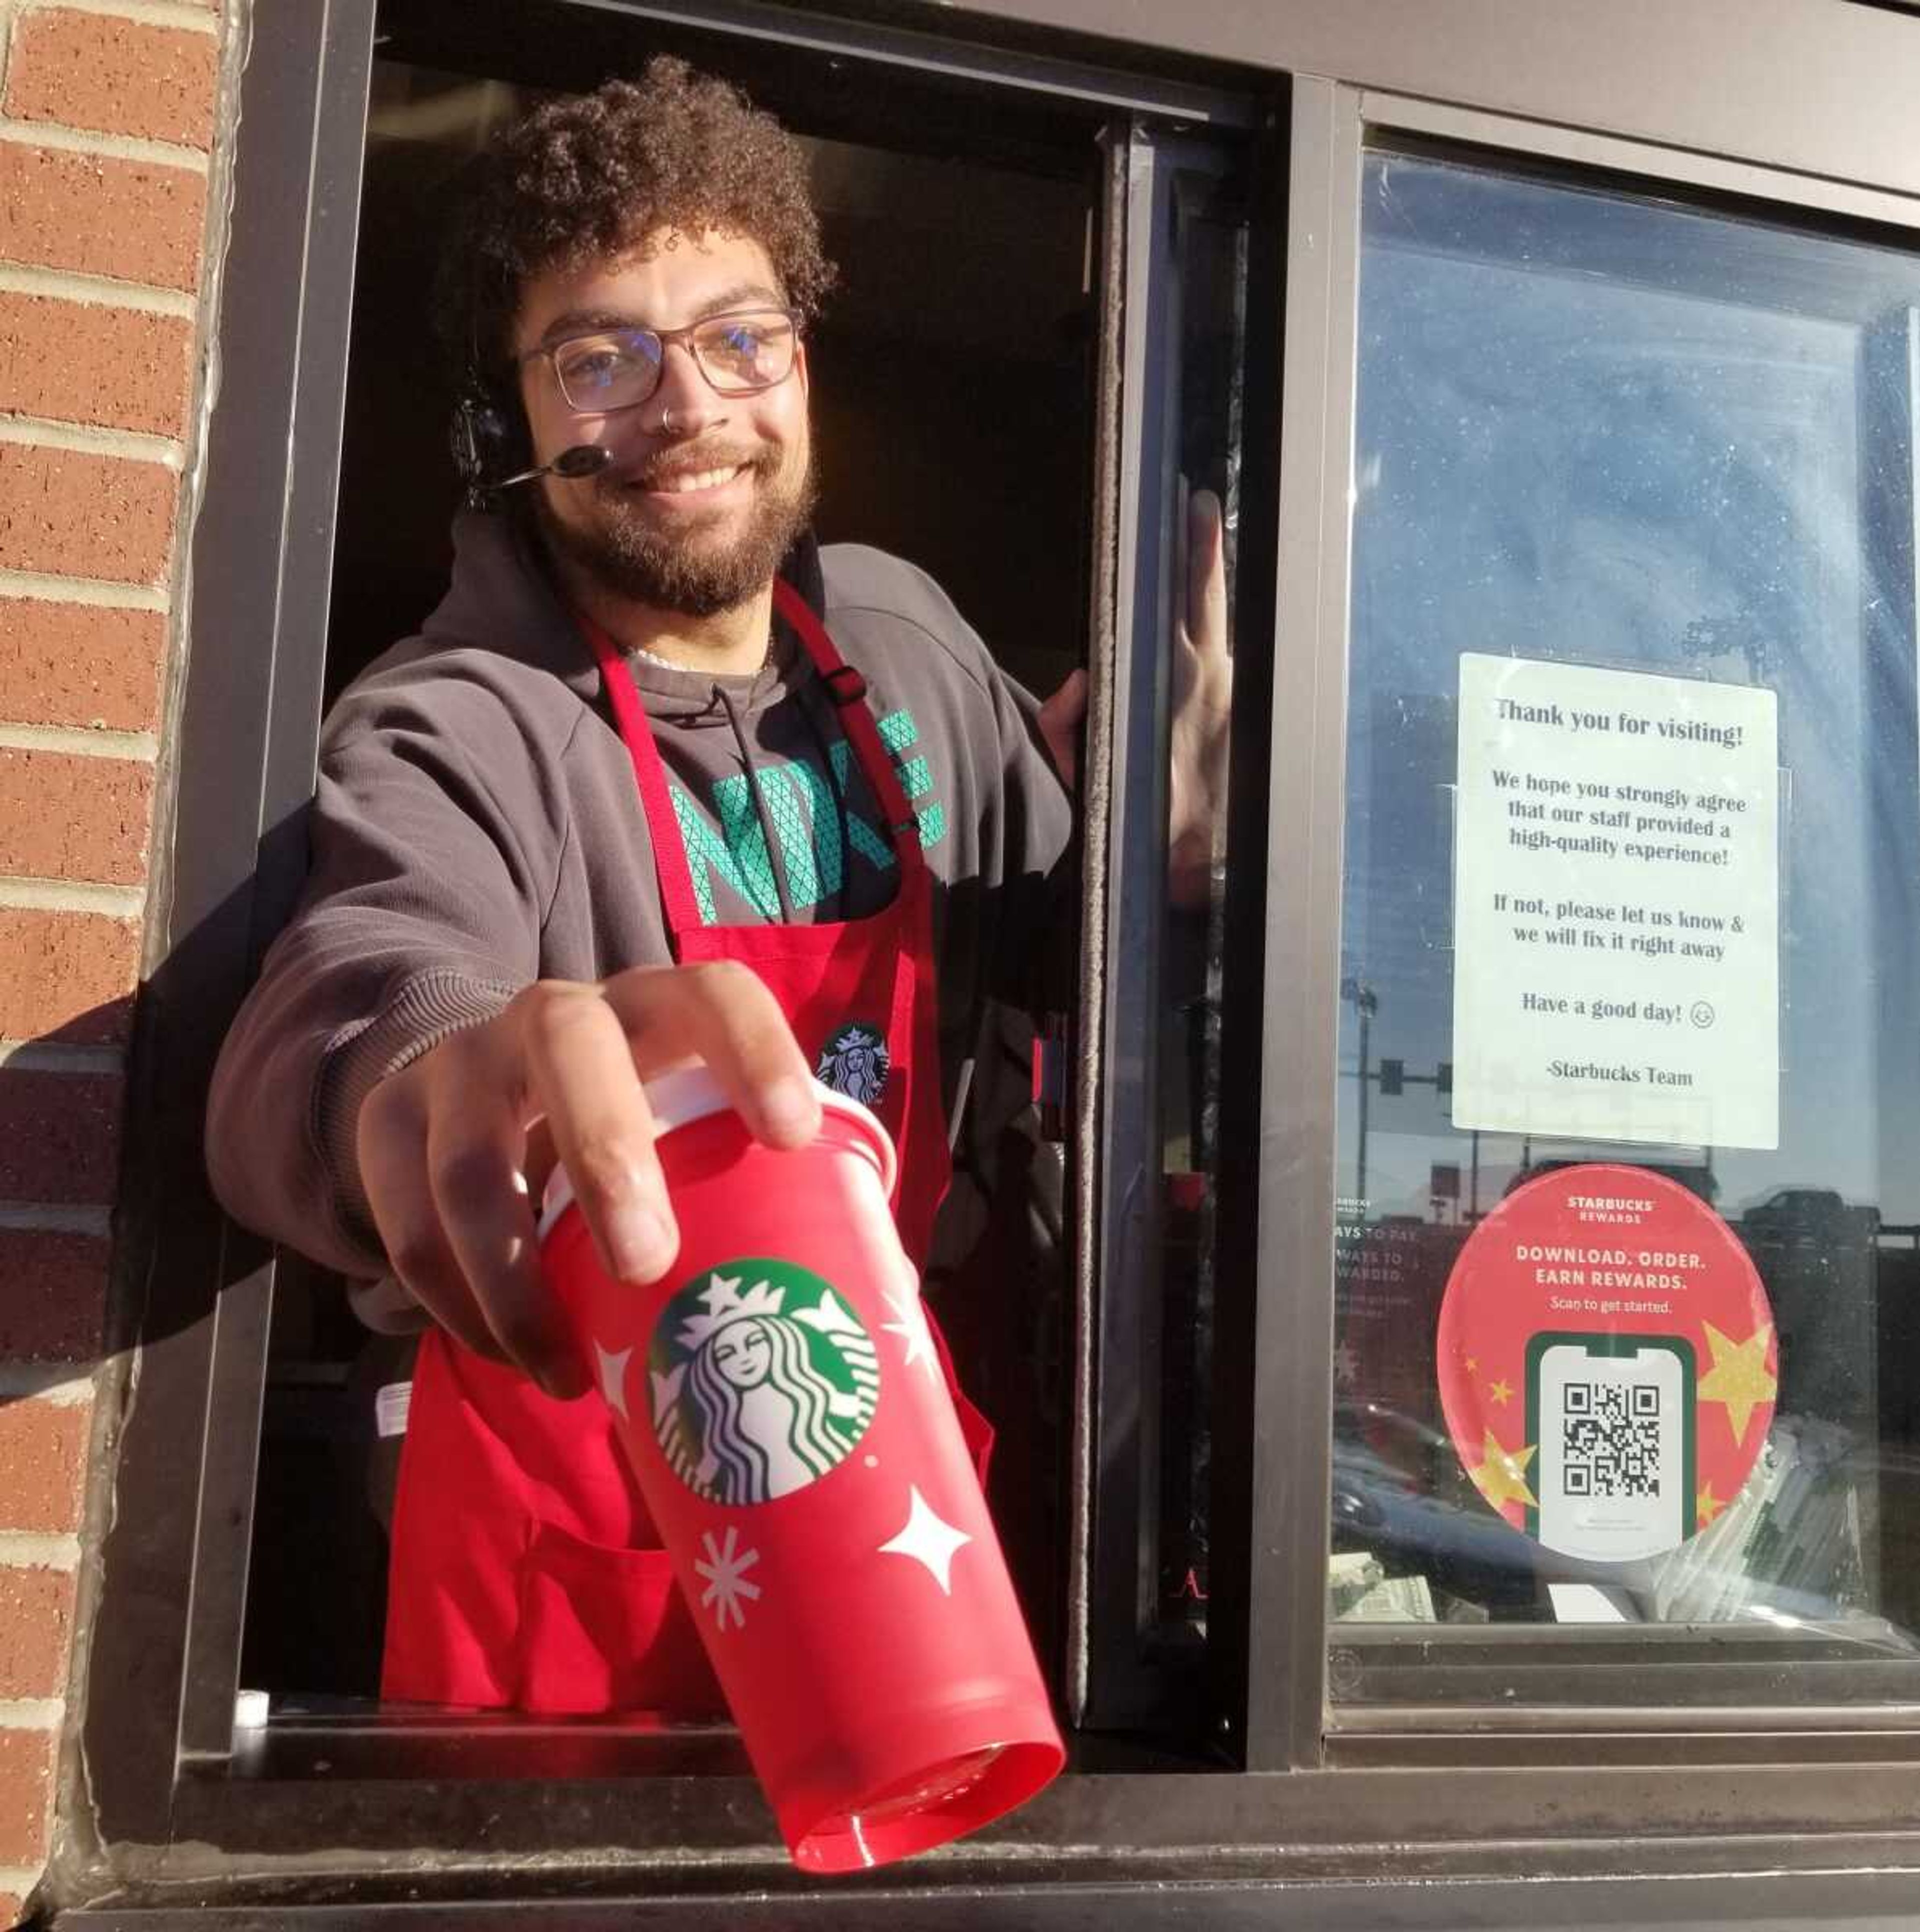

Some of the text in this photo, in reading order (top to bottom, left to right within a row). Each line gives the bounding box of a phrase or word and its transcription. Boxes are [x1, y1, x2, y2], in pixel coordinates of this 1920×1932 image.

[1496, 699, 1742, 749] Thank you for visiting!
[1493, 770, 1746, 813] We hope you strongly agree
[1508, 800, 1730, 838] that our staff provided a
[1510, 828, 1728, 865] high-quality experience!
[1494, 894, 1744, 932] If not, please let us know &
[1514, 928, 1724, 962] we will fix it right away
[1523, 993, 1681, 1024] Have a good day!
[1546, 1060, 1692, 1086] -Starbucks Team
[1568, 1196, 1652, 1211] STARBUCKS
[1580, 1211, 1640, 1224] REWARDS
[1517, 1246, 1705, 1268] DOWNLOAD. ORDER.
[1536, 1269, 1686, 1289] EARN REWARDS.
[1550, 1296, 1582, 1311] Scan
[1584, 1299, 1597, 1310] to
[1624, 1301, 1672, 1313] started.
